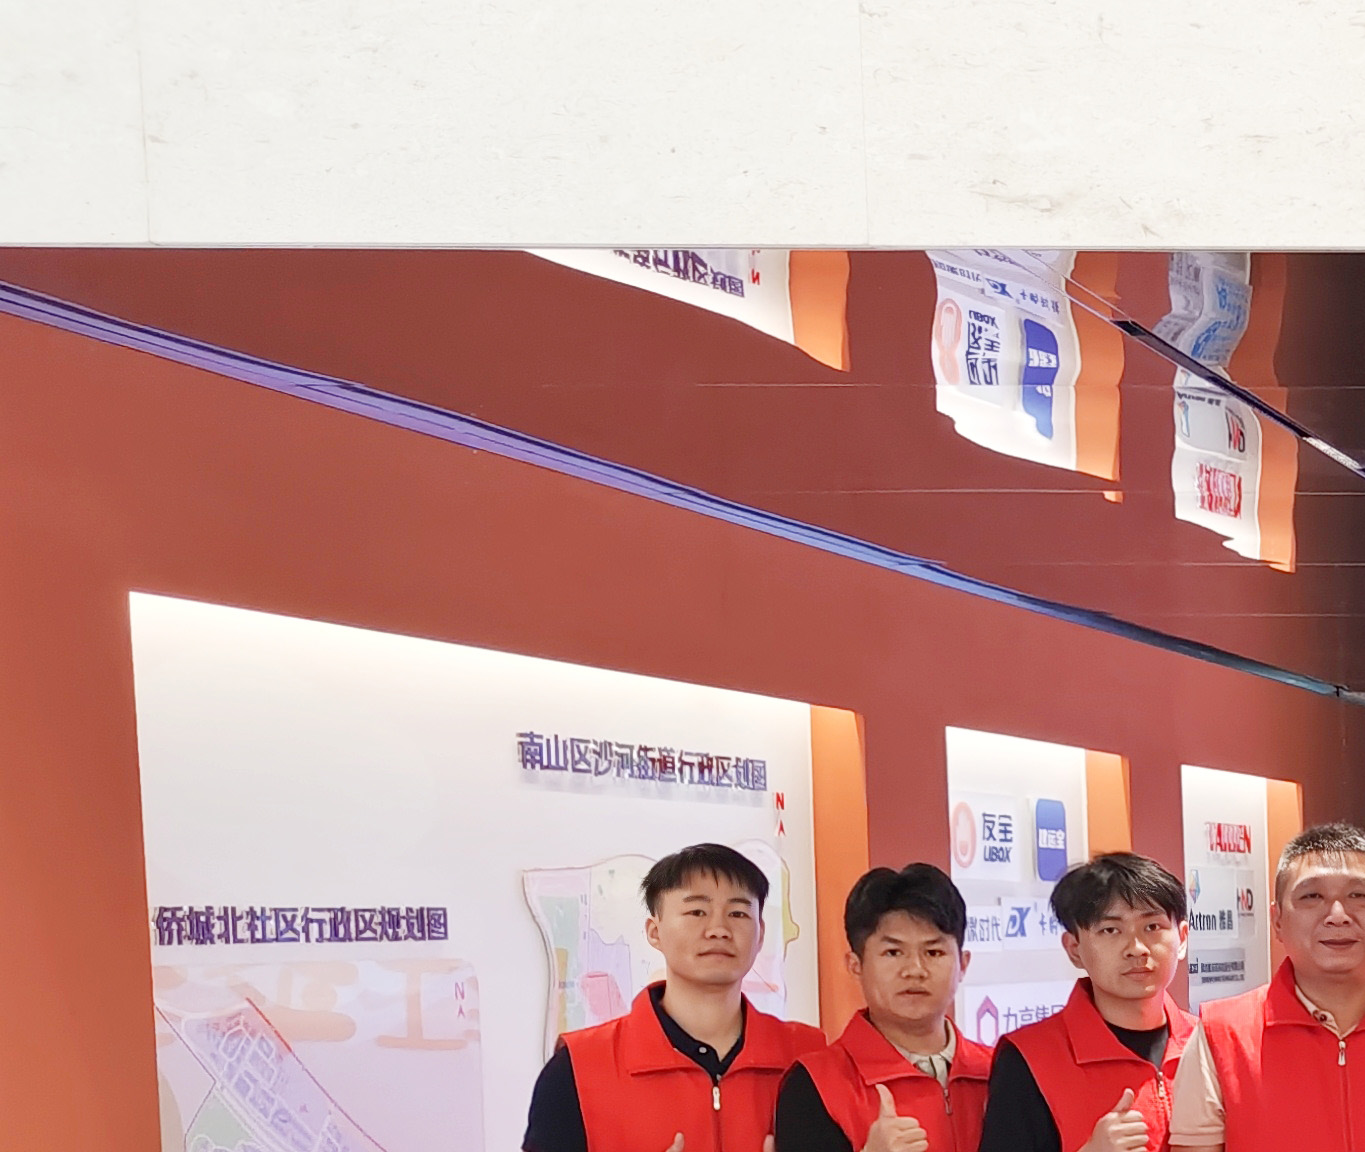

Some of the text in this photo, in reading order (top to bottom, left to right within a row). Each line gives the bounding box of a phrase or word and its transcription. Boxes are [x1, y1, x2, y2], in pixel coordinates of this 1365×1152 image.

[153, 906, 449, 945] 侨城北社区行政区规划图
